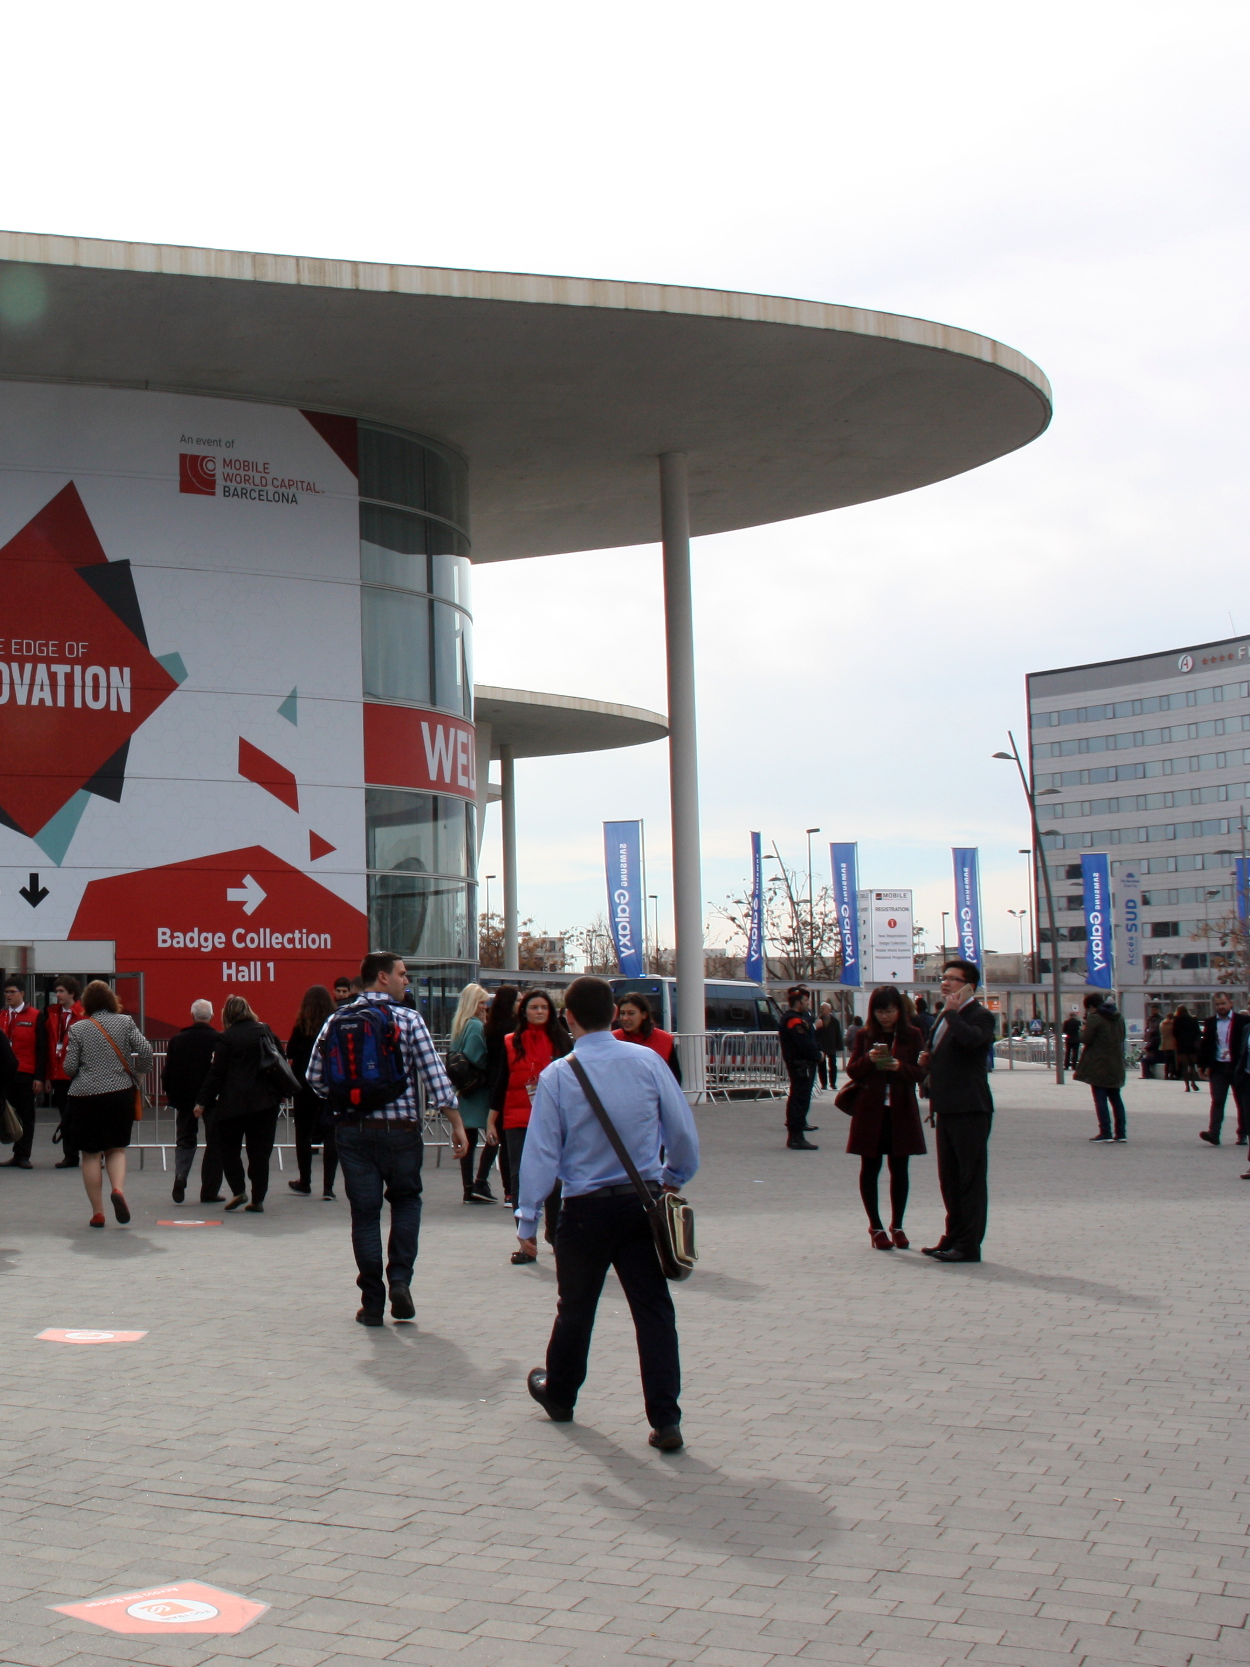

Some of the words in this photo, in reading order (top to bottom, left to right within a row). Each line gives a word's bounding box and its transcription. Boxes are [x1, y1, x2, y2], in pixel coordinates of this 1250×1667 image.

[179, 434, 193, 444] An
[195, 436, 222, 447] event
[225, 439, 235, 449] of
[223, 458, 270, 474] MOBILE
[222, 472, 268, 487] WORLD
[223, 485, 298, 505] BARCELONA
[11, 639, 59, 657] EDGE
[65, 641, 89, 658] OF
[1125, 898, 1138, 933] SUD
[157, 927, 226, 952] Badge
[232, 928, 331, 949] Collection
[222, 961, 261, 982] Hall
[267, 961, 275, 982] 1
